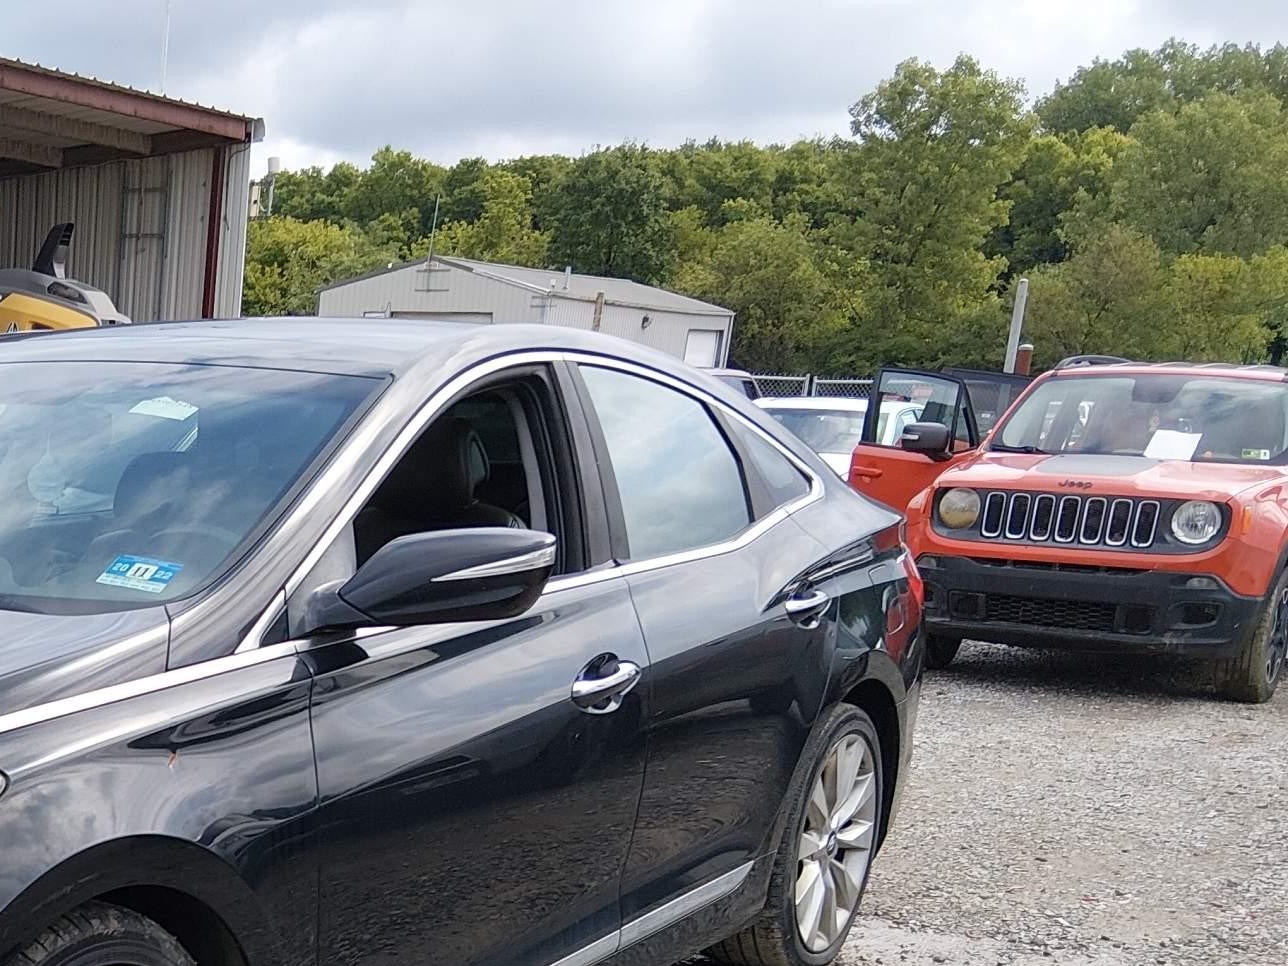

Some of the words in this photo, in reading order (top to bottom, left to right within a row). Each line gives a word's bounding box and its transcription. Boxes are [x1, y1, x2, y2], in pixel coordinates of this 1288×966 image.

[1057, 479, 1093, 490] Jeep
[112, 562, 130, 572] 20
[133, 566, 150, 577] 11
